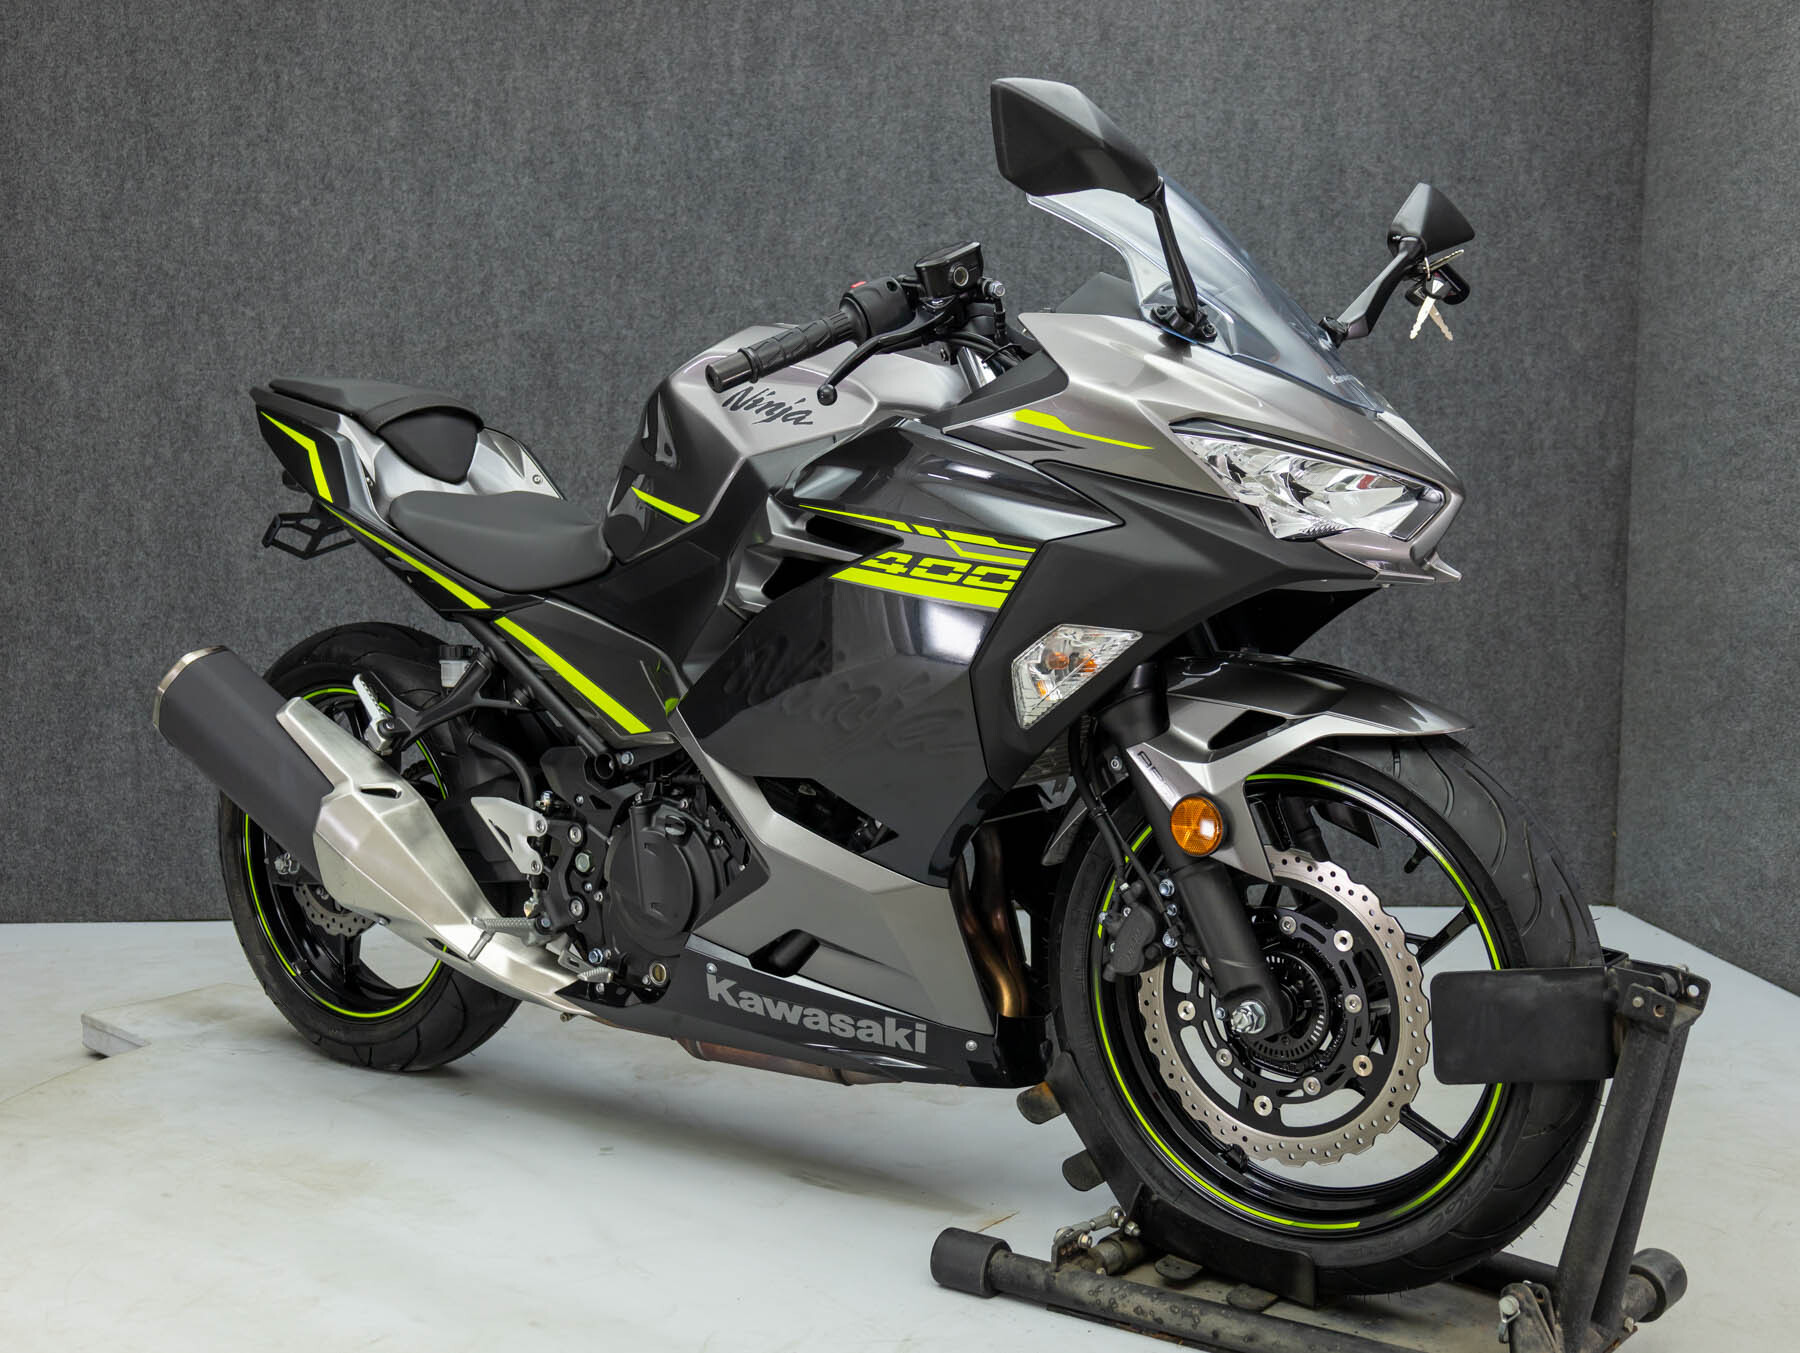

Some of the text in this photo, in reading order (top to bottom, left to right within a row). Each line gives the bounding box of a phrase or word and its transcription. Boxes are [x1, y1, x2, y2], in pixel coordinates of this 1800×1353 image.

[722, 386, 814, 425] Ninja
[859, 551, 1023, 591] 400
[724, 635, 978, 758] Ninja
[705, 971, 927, 1054] Kawasaki
